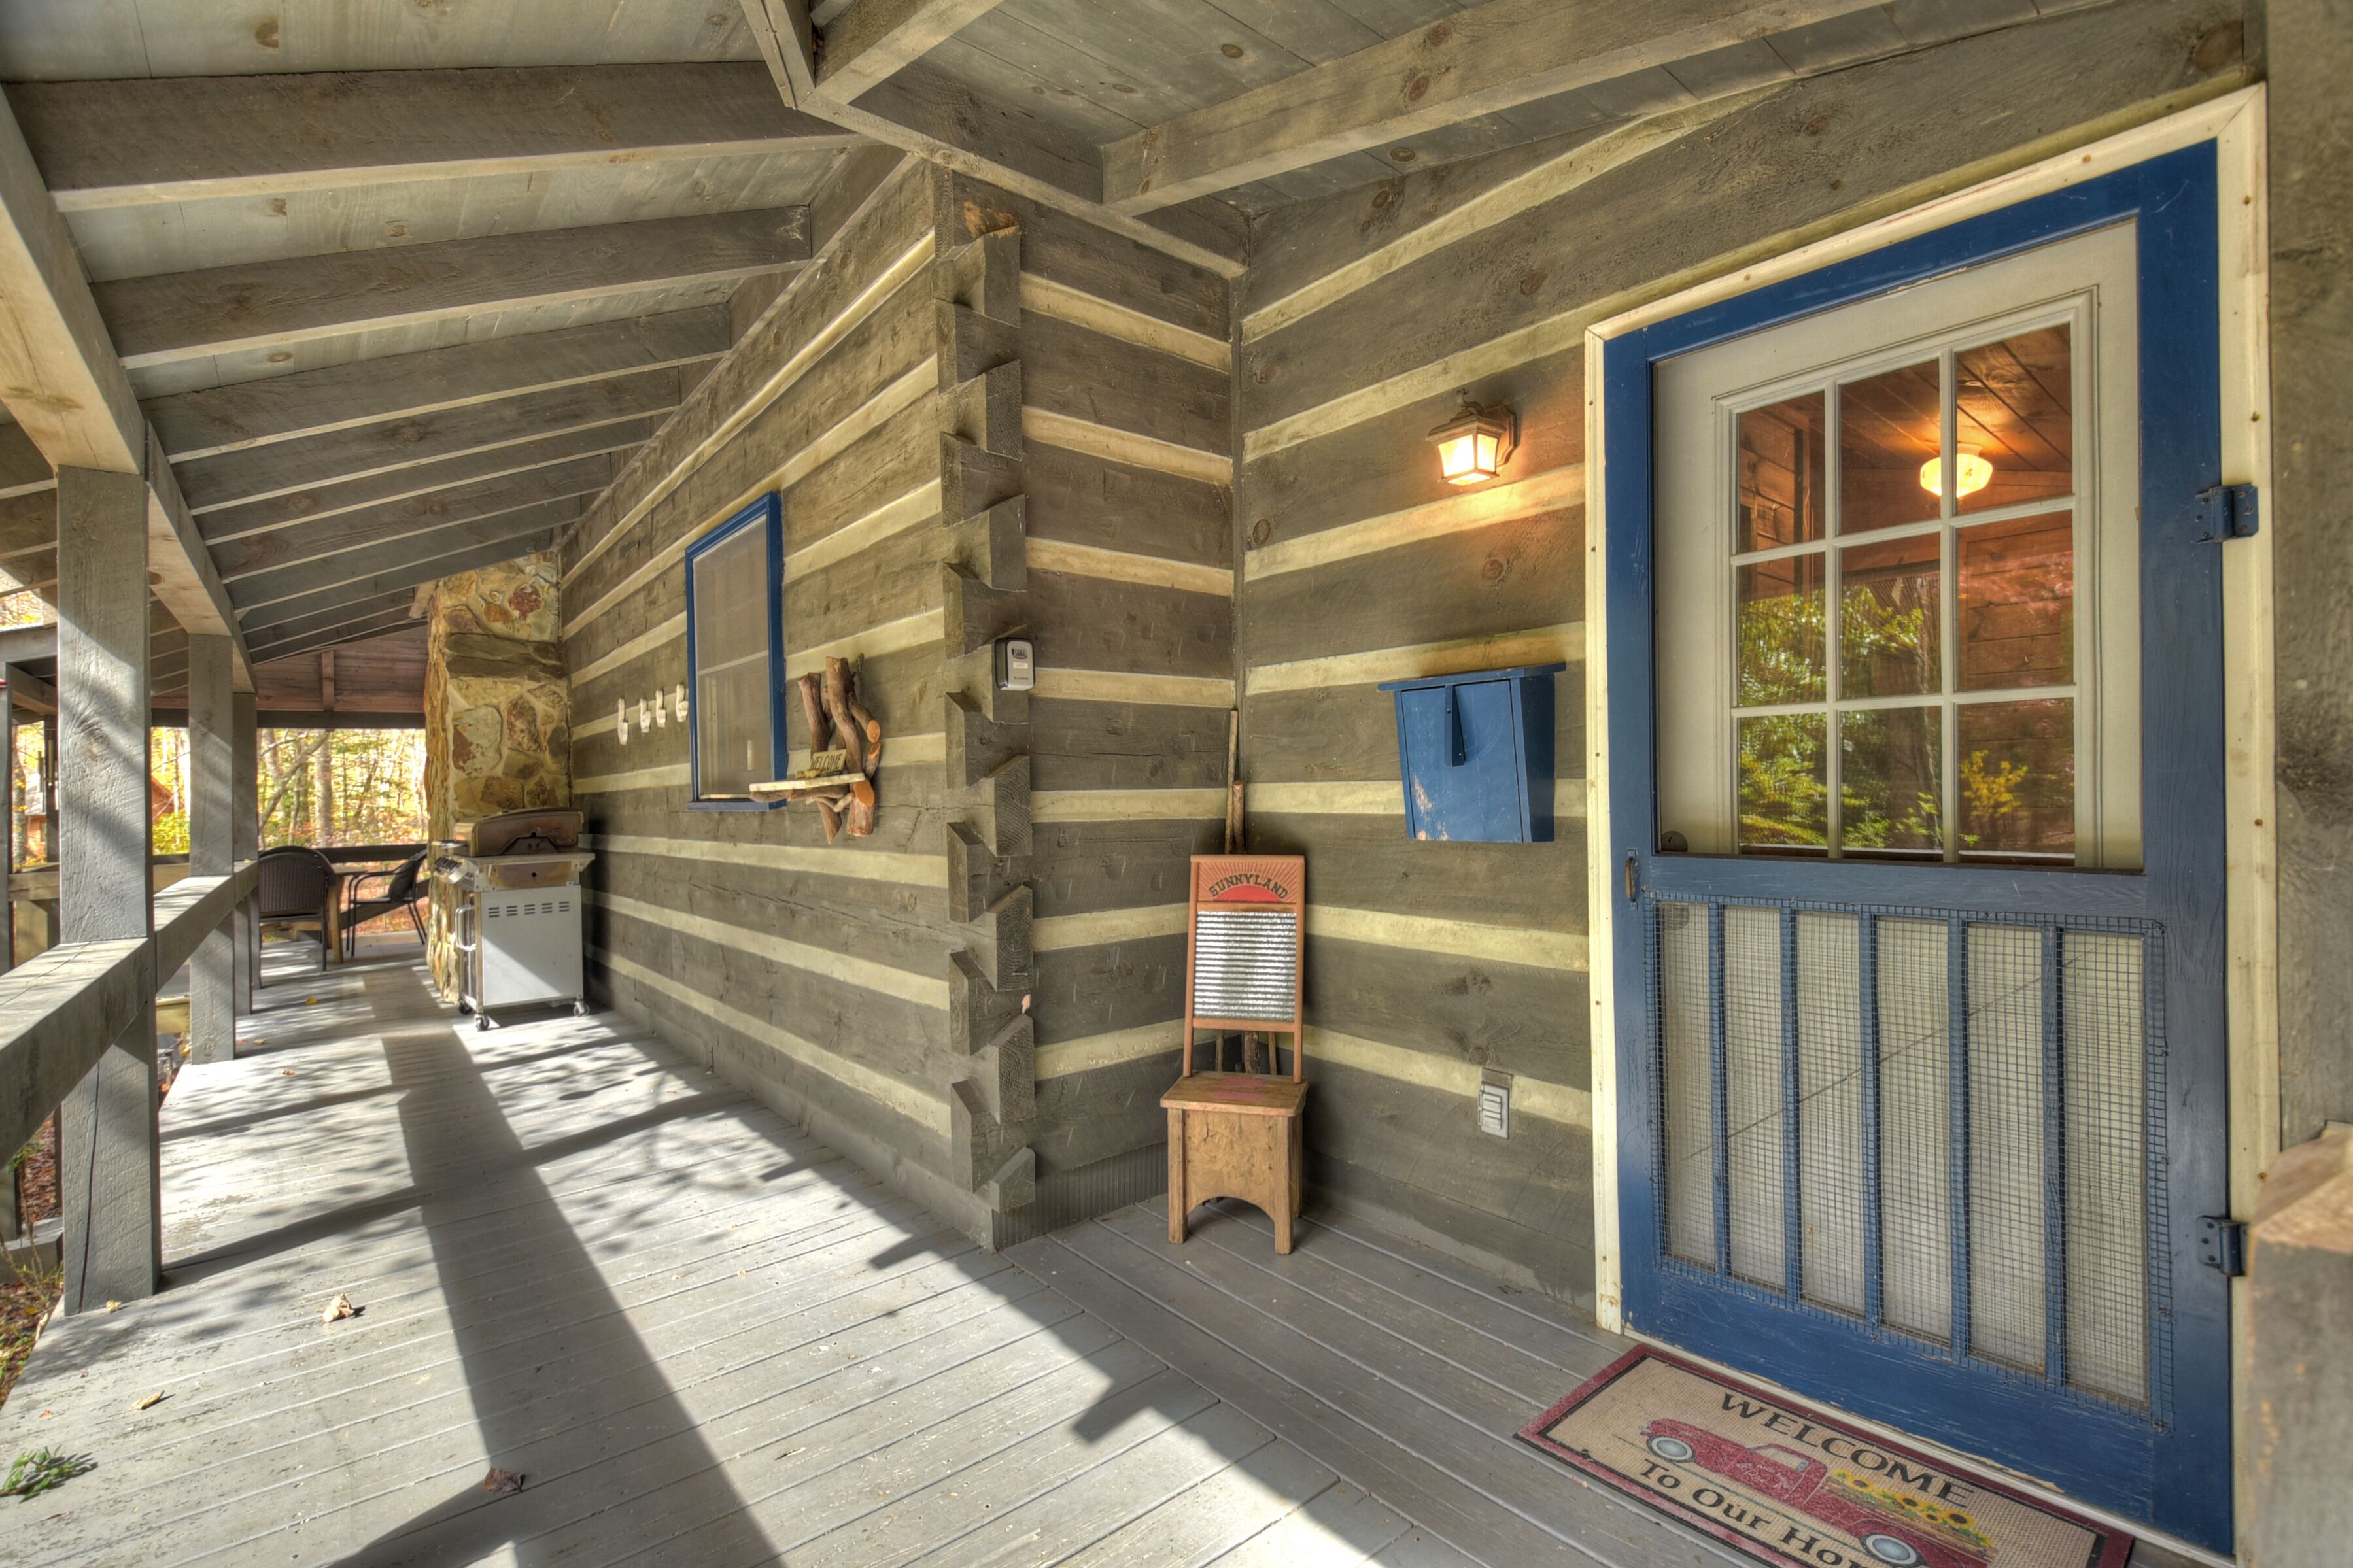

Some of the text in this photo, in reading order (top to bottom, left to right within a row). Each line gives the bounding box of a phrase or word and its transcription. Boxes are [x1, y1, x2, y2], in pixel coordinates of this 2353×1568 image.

[811, 754, 842, 770] WELCOME
[1209, 873, 1288, 900] SUNNYLAND
[1721, 1393, 1974, 1508] WELCOME
[1633, 1459, 1870, 1567] To Our Ho
